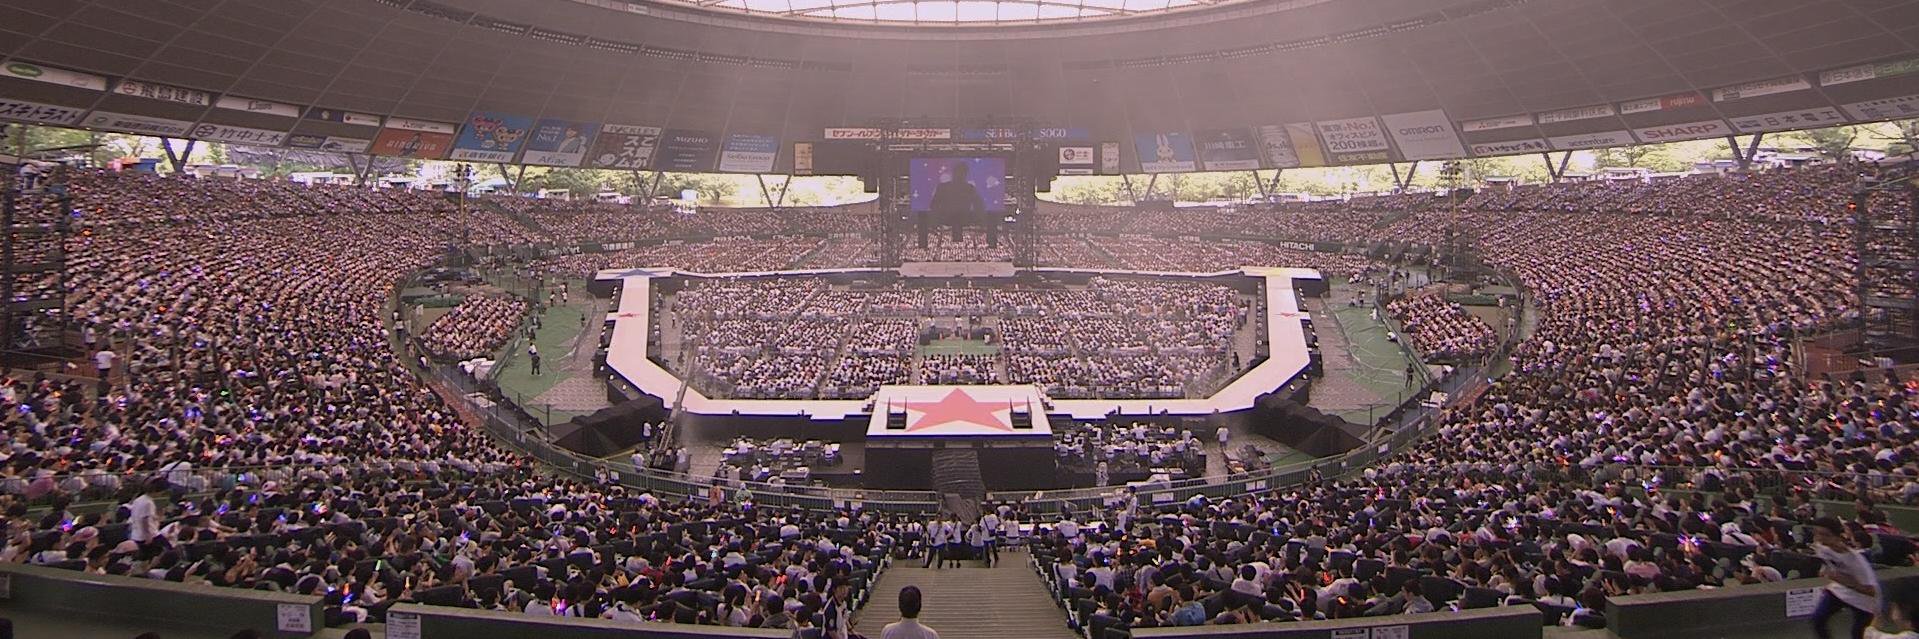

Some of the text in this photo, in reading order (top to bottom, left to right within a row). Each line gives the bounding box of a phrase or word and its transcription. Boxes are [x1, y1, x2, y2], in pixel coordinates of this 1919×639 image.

[219, 128, 280, 143] 竹中土木
[1643, 123, 1718, 139] SHARP
[1279, 240, 1315, 251] HITACHI
